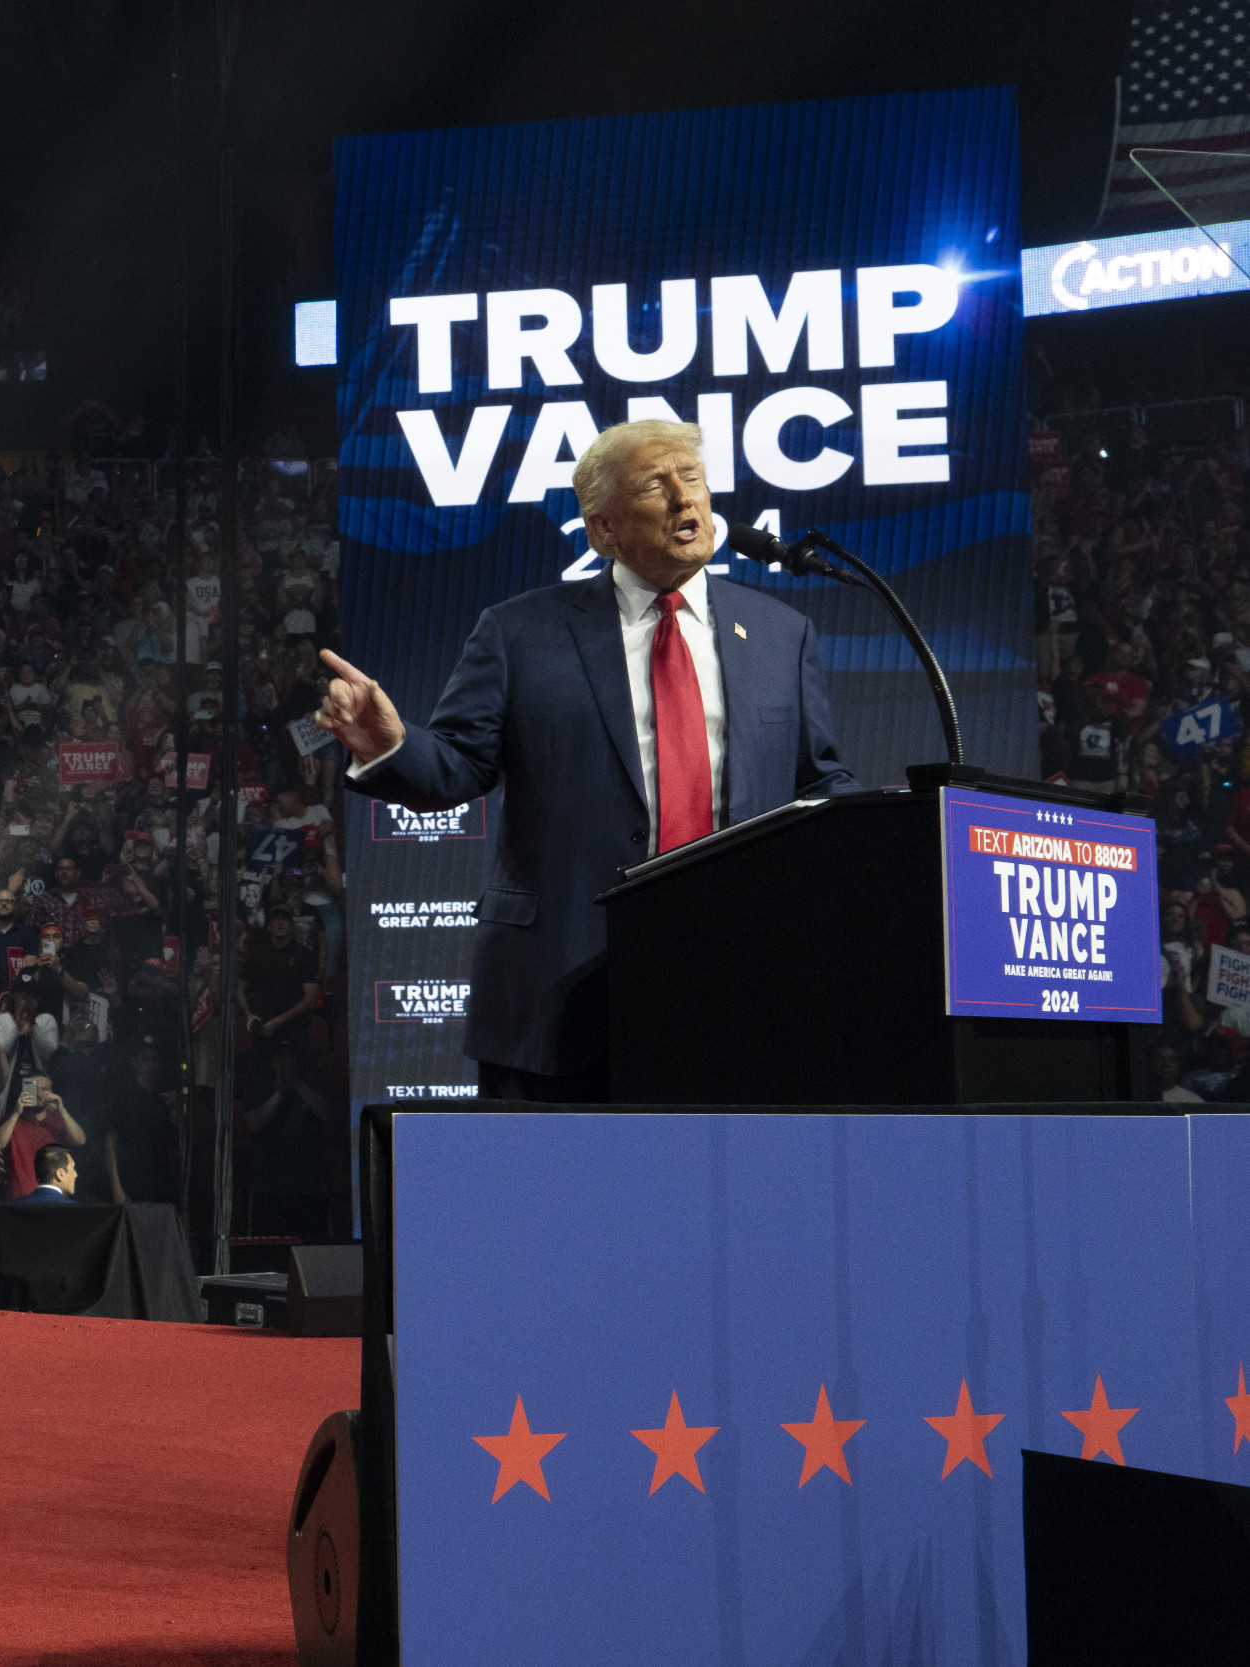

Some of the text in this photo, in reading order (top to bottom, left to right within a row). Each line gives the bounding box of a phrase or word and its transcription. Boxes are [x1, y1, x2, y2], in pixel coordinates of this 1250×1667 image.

[1080, 243, 1230, 295] ACTION
[390, 263, 959, 393] TRUMP
[396, 380, 950, 506] VANCE
[561, 508, 781, 581] 224
[1177, 703, 1222, 745] 47
[63, 752, 116, 764] TRUMP
[69, 762, 110, 771] VANCE
[397, 817, 461, 831] VANCE
[974, 828, 1133, 870] TEXT ARIZONA TO 88022
[993, 861, 1118, 921] TRUMP
[371, 901, 478, 914] MAKE AMERIC
[378, 915, 479, 928] GREAT AGAIN
[1009, 917, 1107, 964] VANCE
[1004, 964, 1113, 982] MAKE AMERICA GREAT AGAIN!
[1220, 954, 1250, 974] FIGH
[1219, 968, 1250, 989] FIGH
[391, 984, 470, 1001] TRUMP
[1042, 990, 1079, 1013] 2024
[401, 1000, 464, 1012] VANCE
[387, 1085, 426, 1098] TEXT
